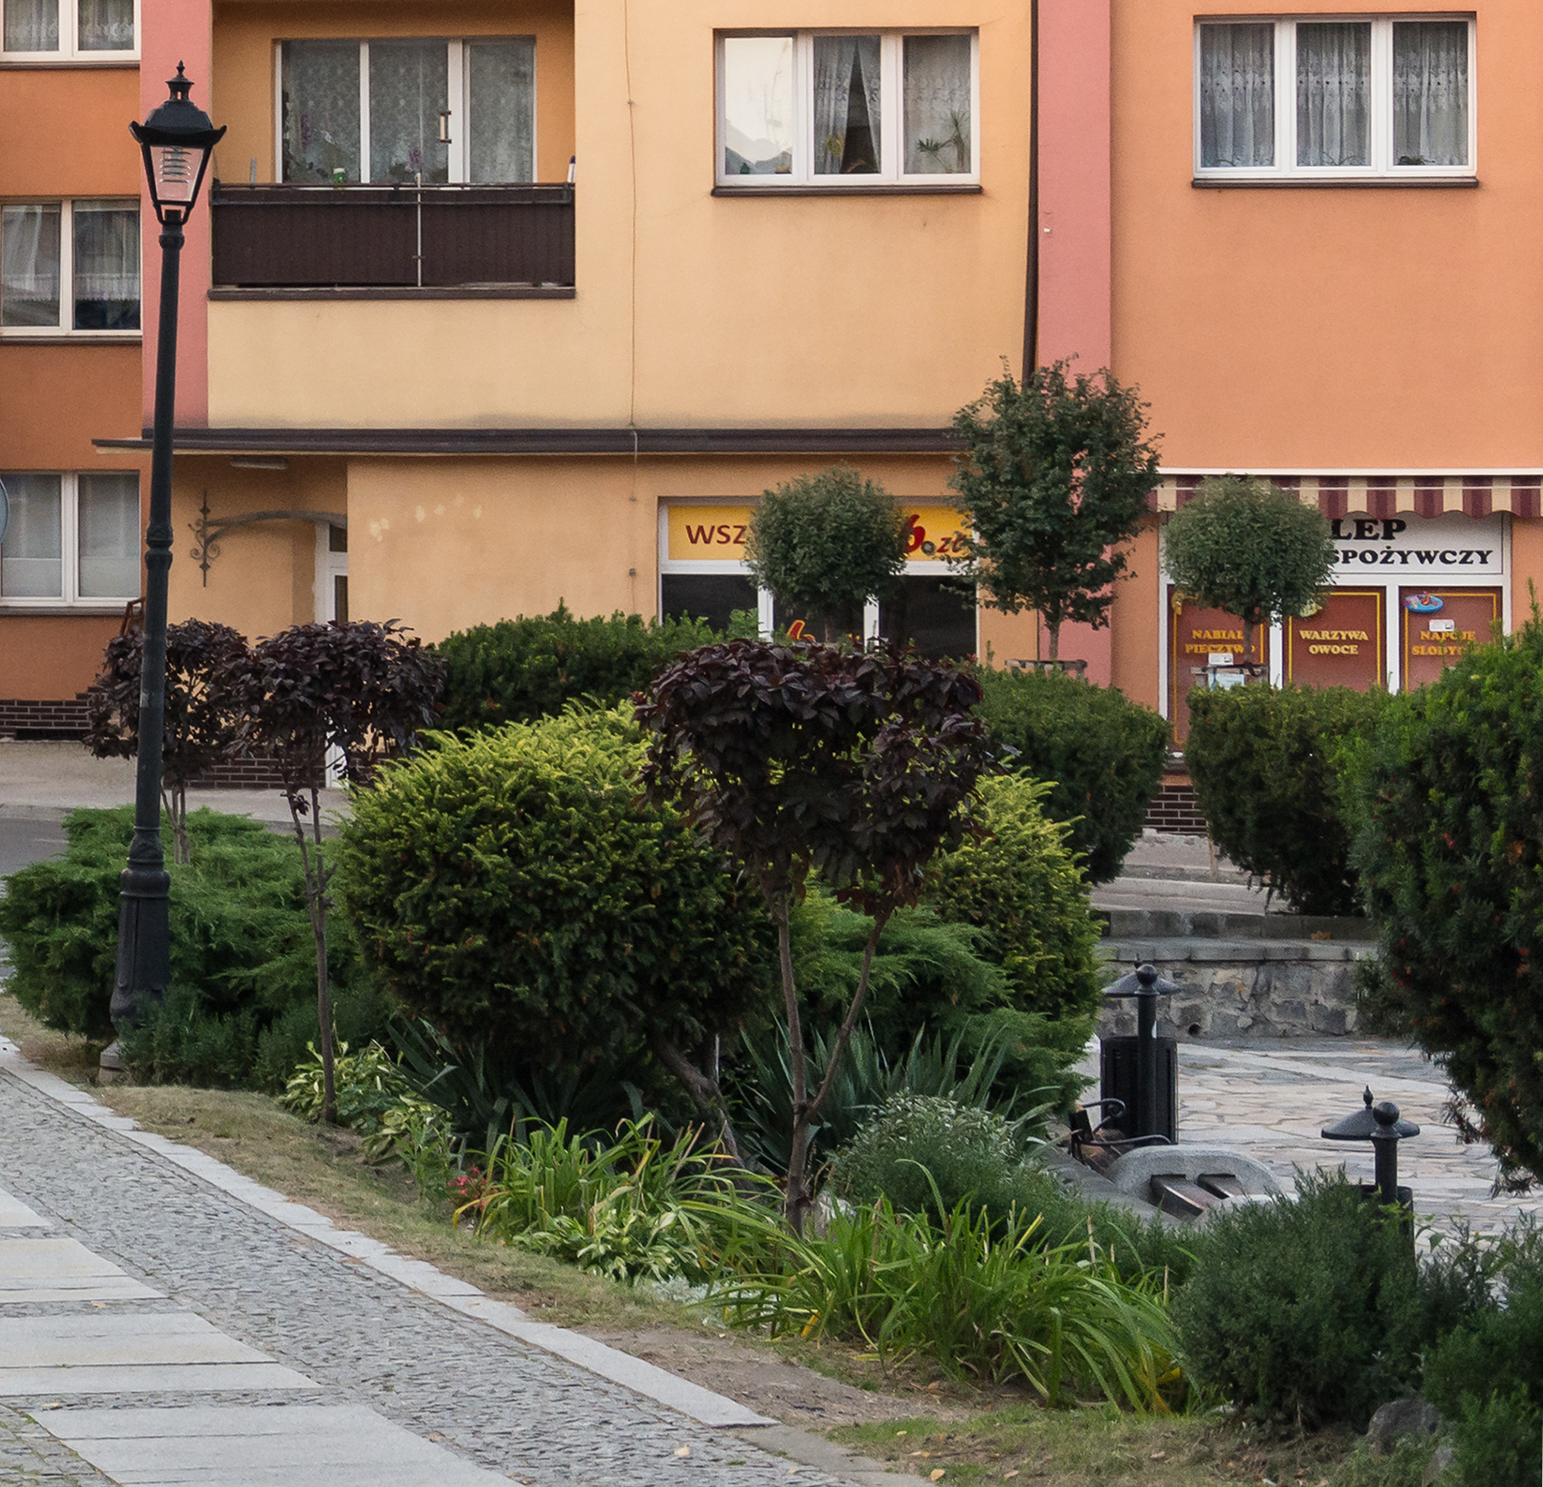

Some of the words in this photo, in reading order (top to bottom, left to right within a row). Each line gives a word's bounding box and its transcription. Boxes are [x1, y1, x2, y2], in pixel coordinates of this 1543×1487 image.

[685, 524, 755, 545] WSZ
[1330, 518, 1407, 541] LEP
[1299, 630, 1369, 641] WARZYWA
[1185, 644, 1255, 654] PIECZYW
[1308, 644, 1359, 655] OWOCE
